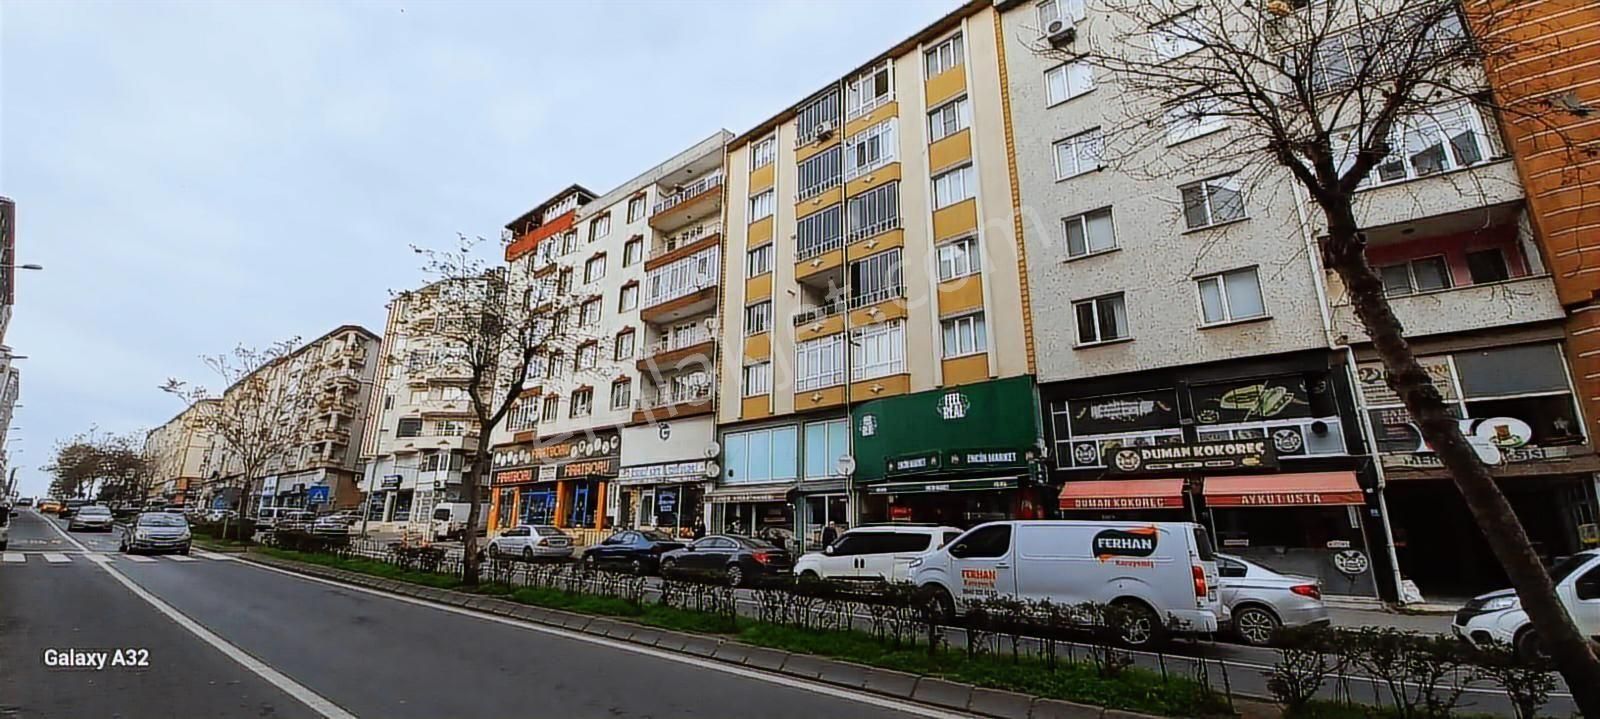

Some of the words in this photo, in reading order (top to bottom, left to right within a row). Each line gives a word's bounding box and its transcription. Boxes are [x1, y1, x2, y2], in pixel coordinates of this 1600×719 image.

[944, 393, 961, 405] FEEL
[943, 404, 965, 419] REAL
[1141, 446, 1191, 460] DUMAN
[1193, 441, 1266, 457] KOKOREÇ
[988, 451, 1017, 462] MARKET
[1075, 499, 1111, 508] DUMAN
[1241, 494, 1282, 504] AYKUT
[1286, 493, 1322, 503] USTA
[1097, 537, 1152, 549] FERHAN
[961, 569, 997, 580] FERHAN
